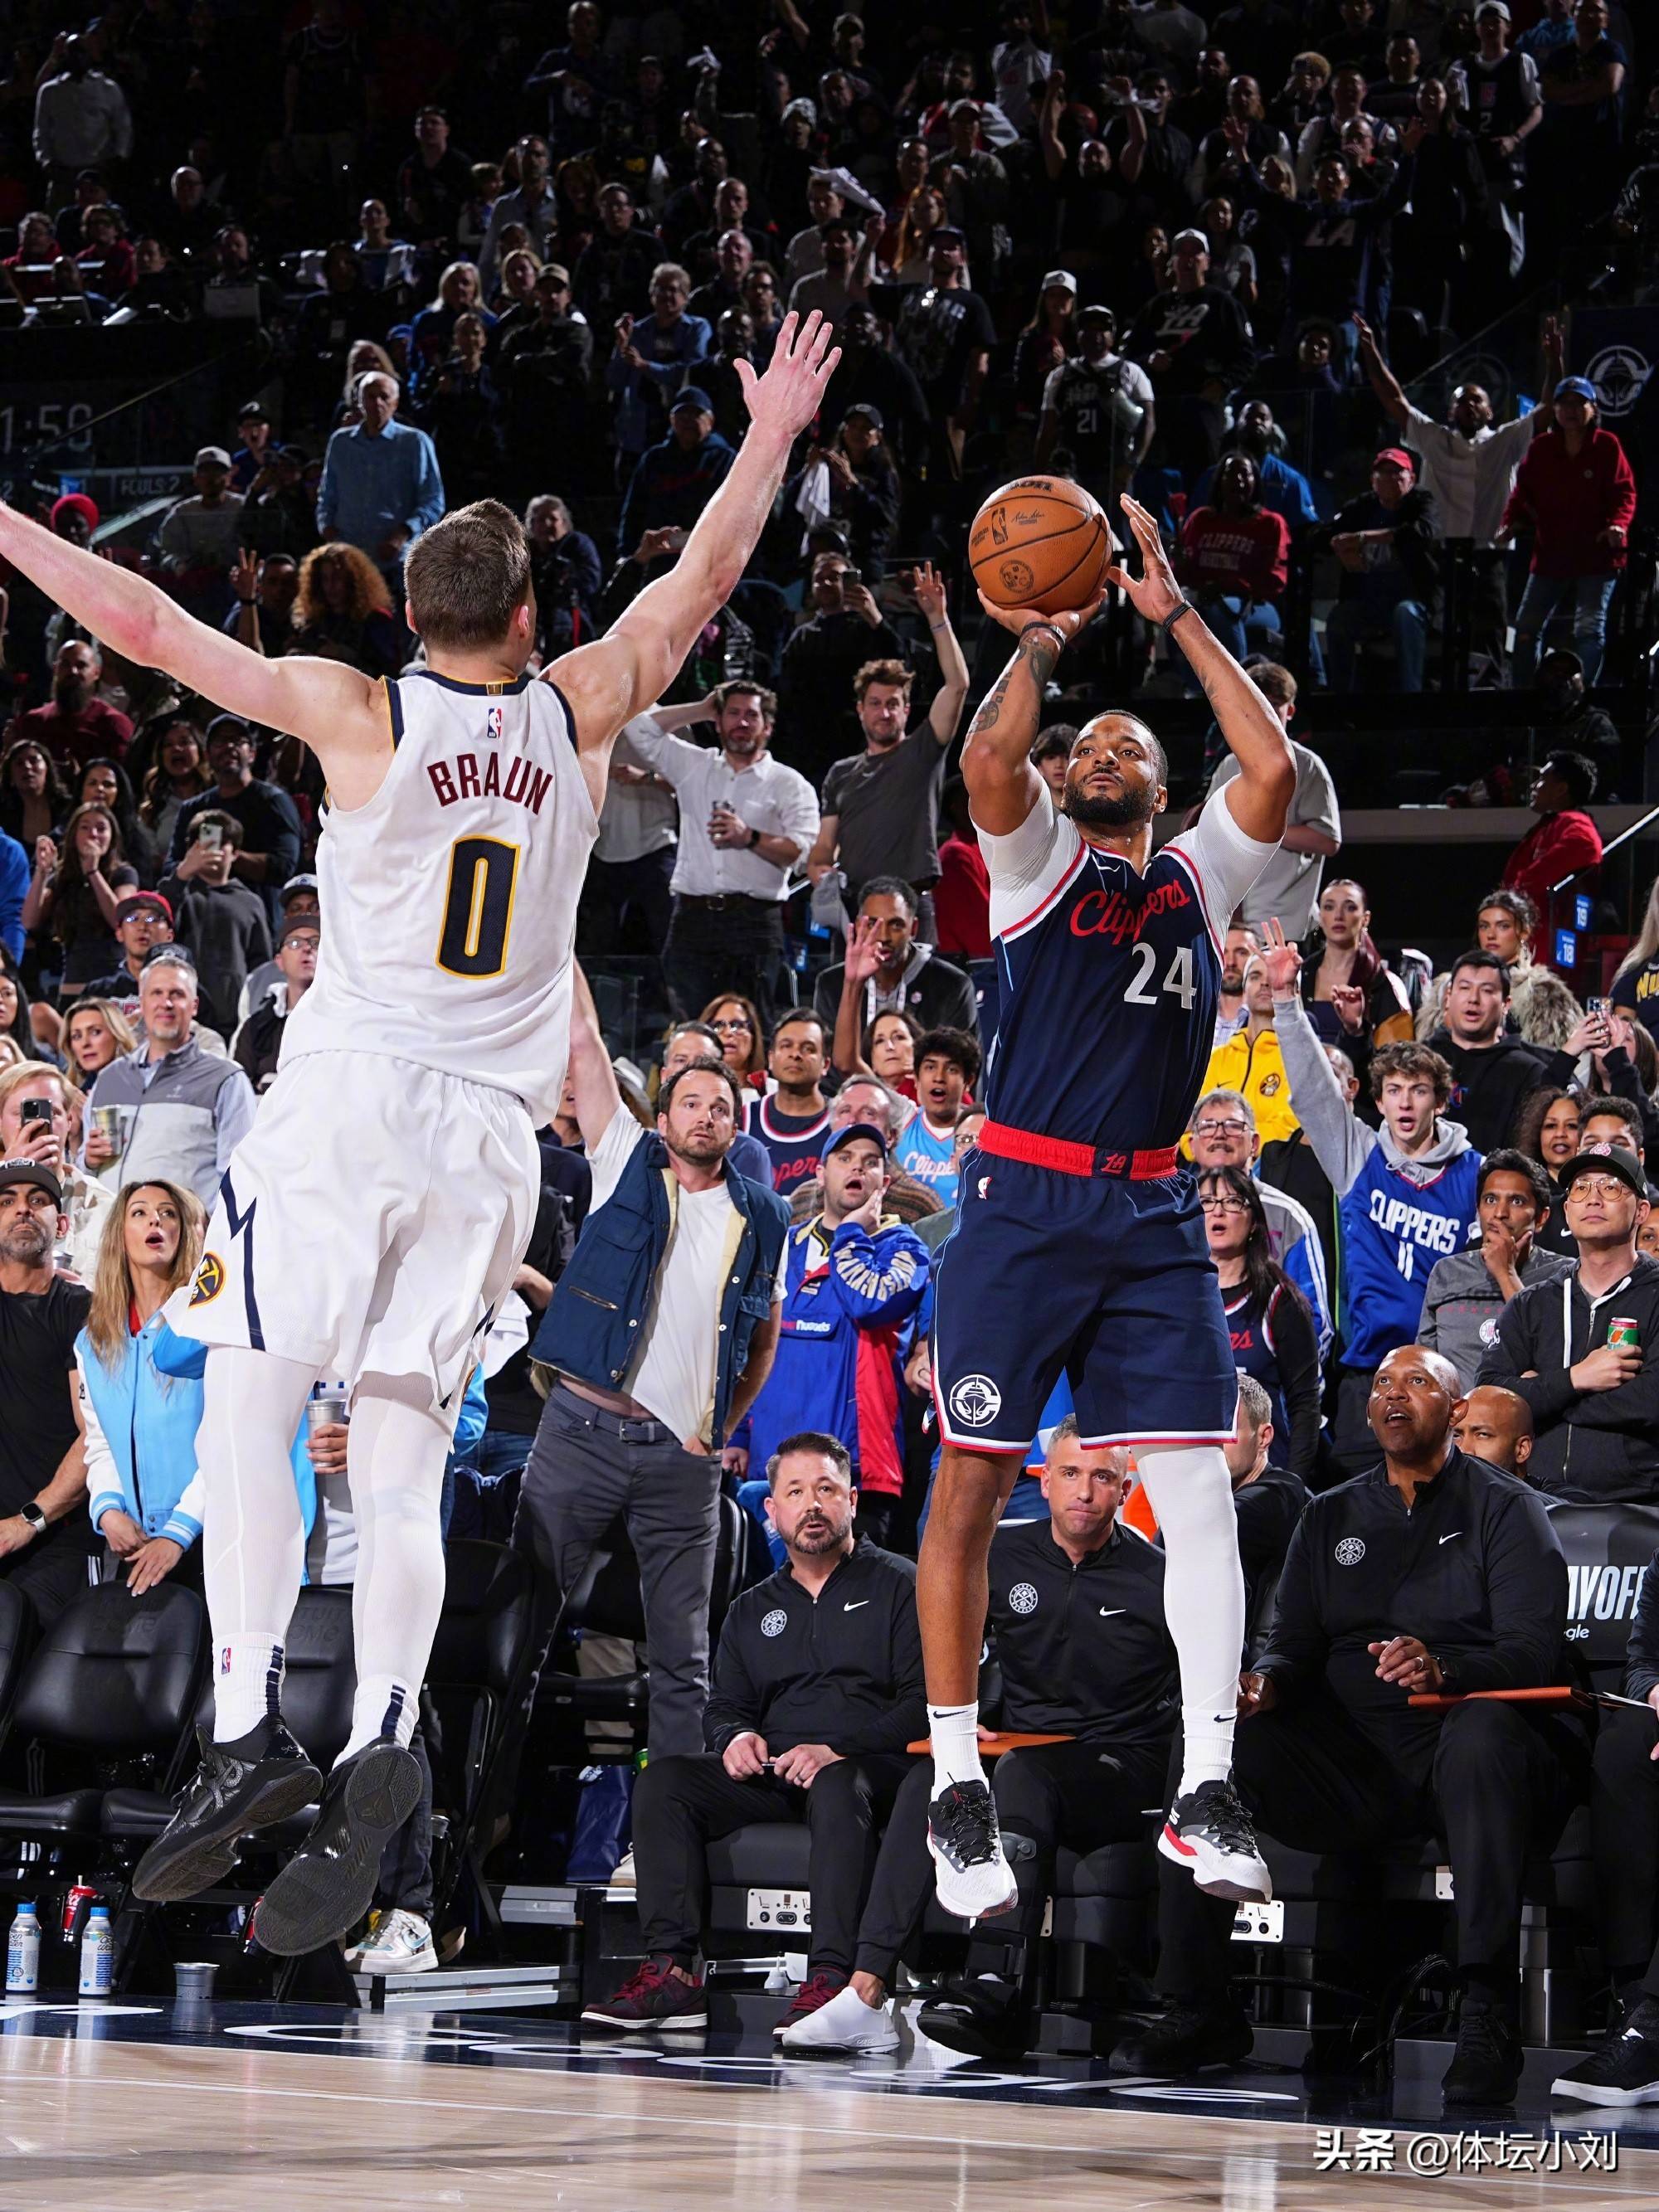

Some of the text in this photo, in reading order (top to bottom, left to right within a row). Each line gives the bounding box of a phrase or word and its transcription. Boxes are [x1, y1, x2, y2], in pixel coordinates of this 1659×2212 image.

[1303, 218, 1355, 247] LA
[1076, 407, 1097, 434] 21
[1198, 533, 1255, 554] CLIPPERS
[427, 752, 553, 815] BRAUN
[435, 834, 521, 980] 0
[1070, 879, 1190, 945] Clippers
[1124, 942, 1197, 1009] 24
[1370, 1189, 1460, 1255] CLIPPERS
[1397, 1240, 1413, 1282] 11
[1564, 1624, 1589, 1641] gle
